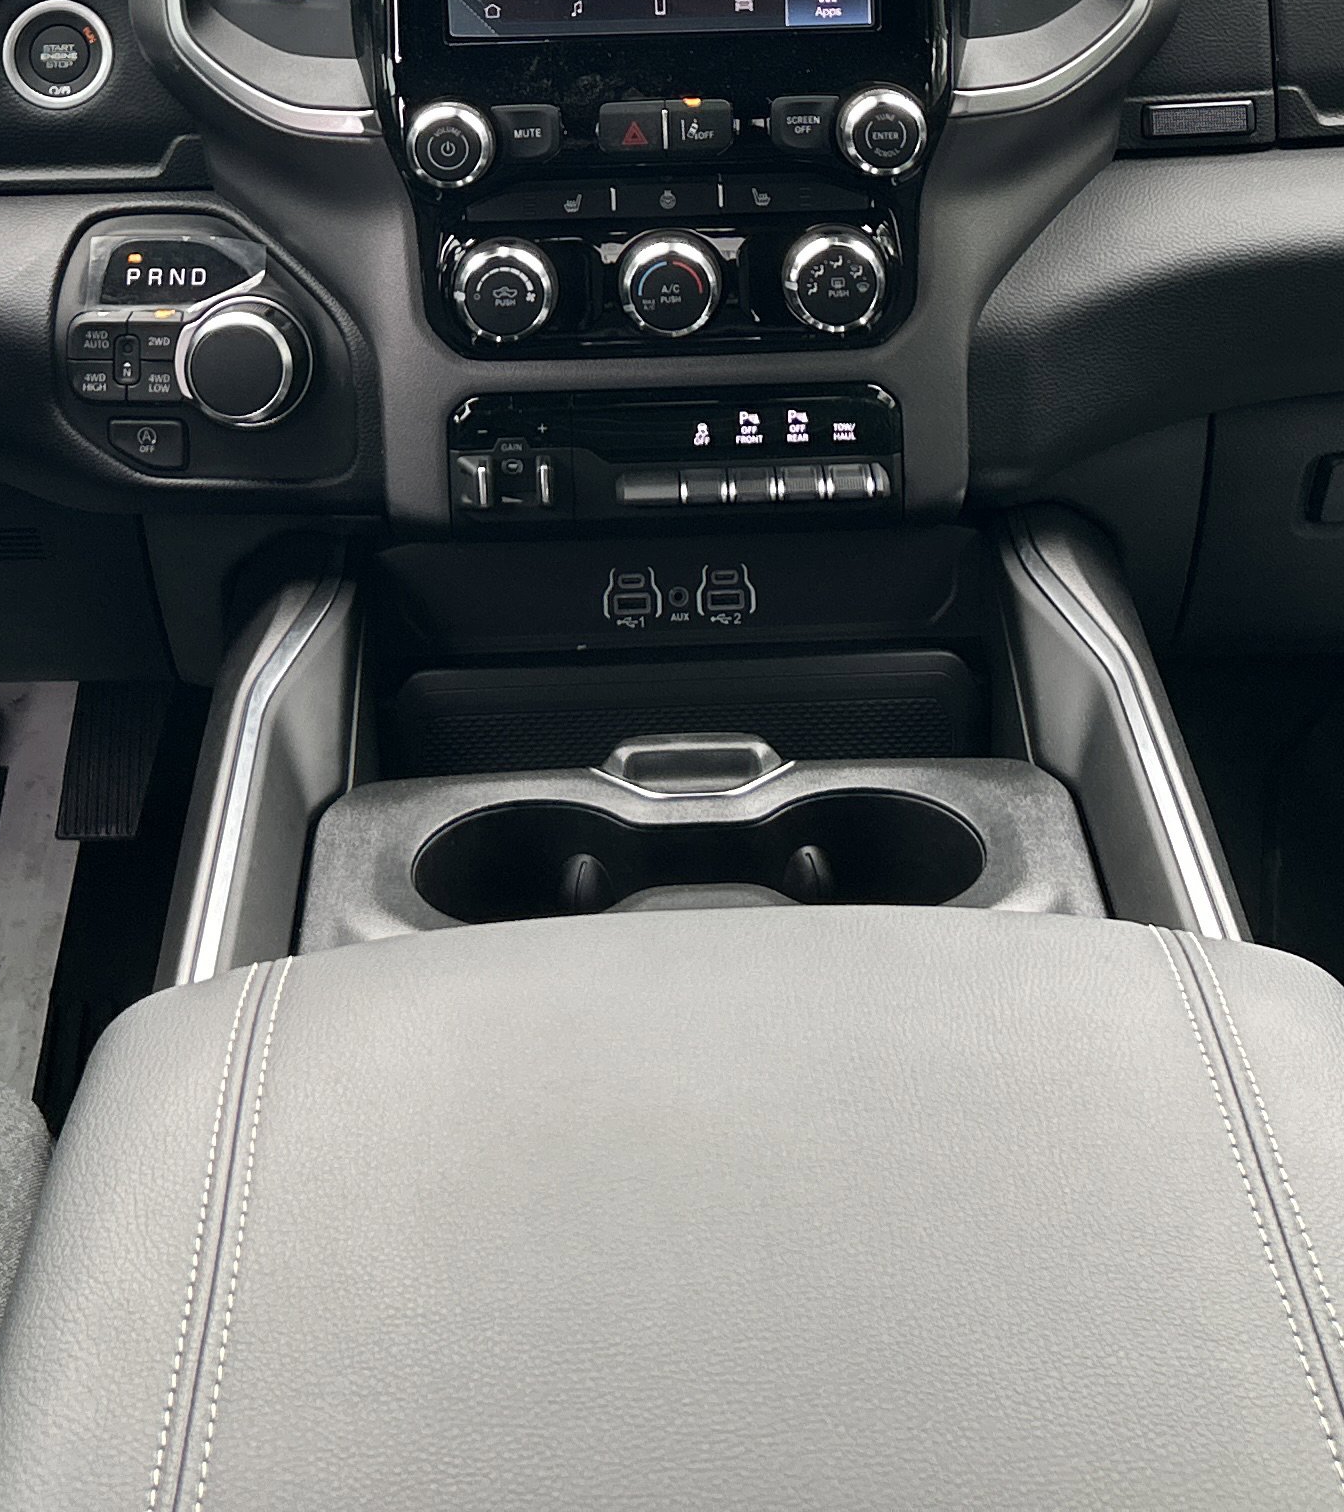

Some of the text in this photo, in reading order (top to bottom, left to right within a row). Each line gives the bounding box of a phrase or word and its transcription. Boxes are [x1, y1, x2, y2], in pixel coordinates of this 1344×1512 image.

[815, 5, 842, 17] Apps
[786, 115, 821, 126] SCREEN
[513, 128, 542, 138] MUTE
[794, 125, 812, 135] OFF
[872, 131, 900, 141] ENTER
[661, 283, 680, 293] A/C
[660, 294, 682, 303] PUSH
[828, 289, 850, 298] PUSH
[495, 298, 516, 307] PUSH
[84, 339, 109, 349] AUTO
[148, 336, 171, 346] 2WD
[123, 367, 132, 377] N
[84, 373, 106, 382] 4WD
[148, 373, 171, 383] 4WD
[82, 383, 107, 392] HIGH
[148, 383, 171, 393] LOW
[741, 426, 758, 435] OFF
[789, 424, 806, 433] OFF
[735, 434, 763, 444] FRONT
[786, 433, 809, 443] REAR
[833, 431, 857, 441] HAUL
[139, 445, 155, 453] OFF
[500, 443, 523, 452] GAIN
[639, 616, 645, 628] 1
[670, 612, 690, 622] AUX
[733, 614, 742, 624] 2
